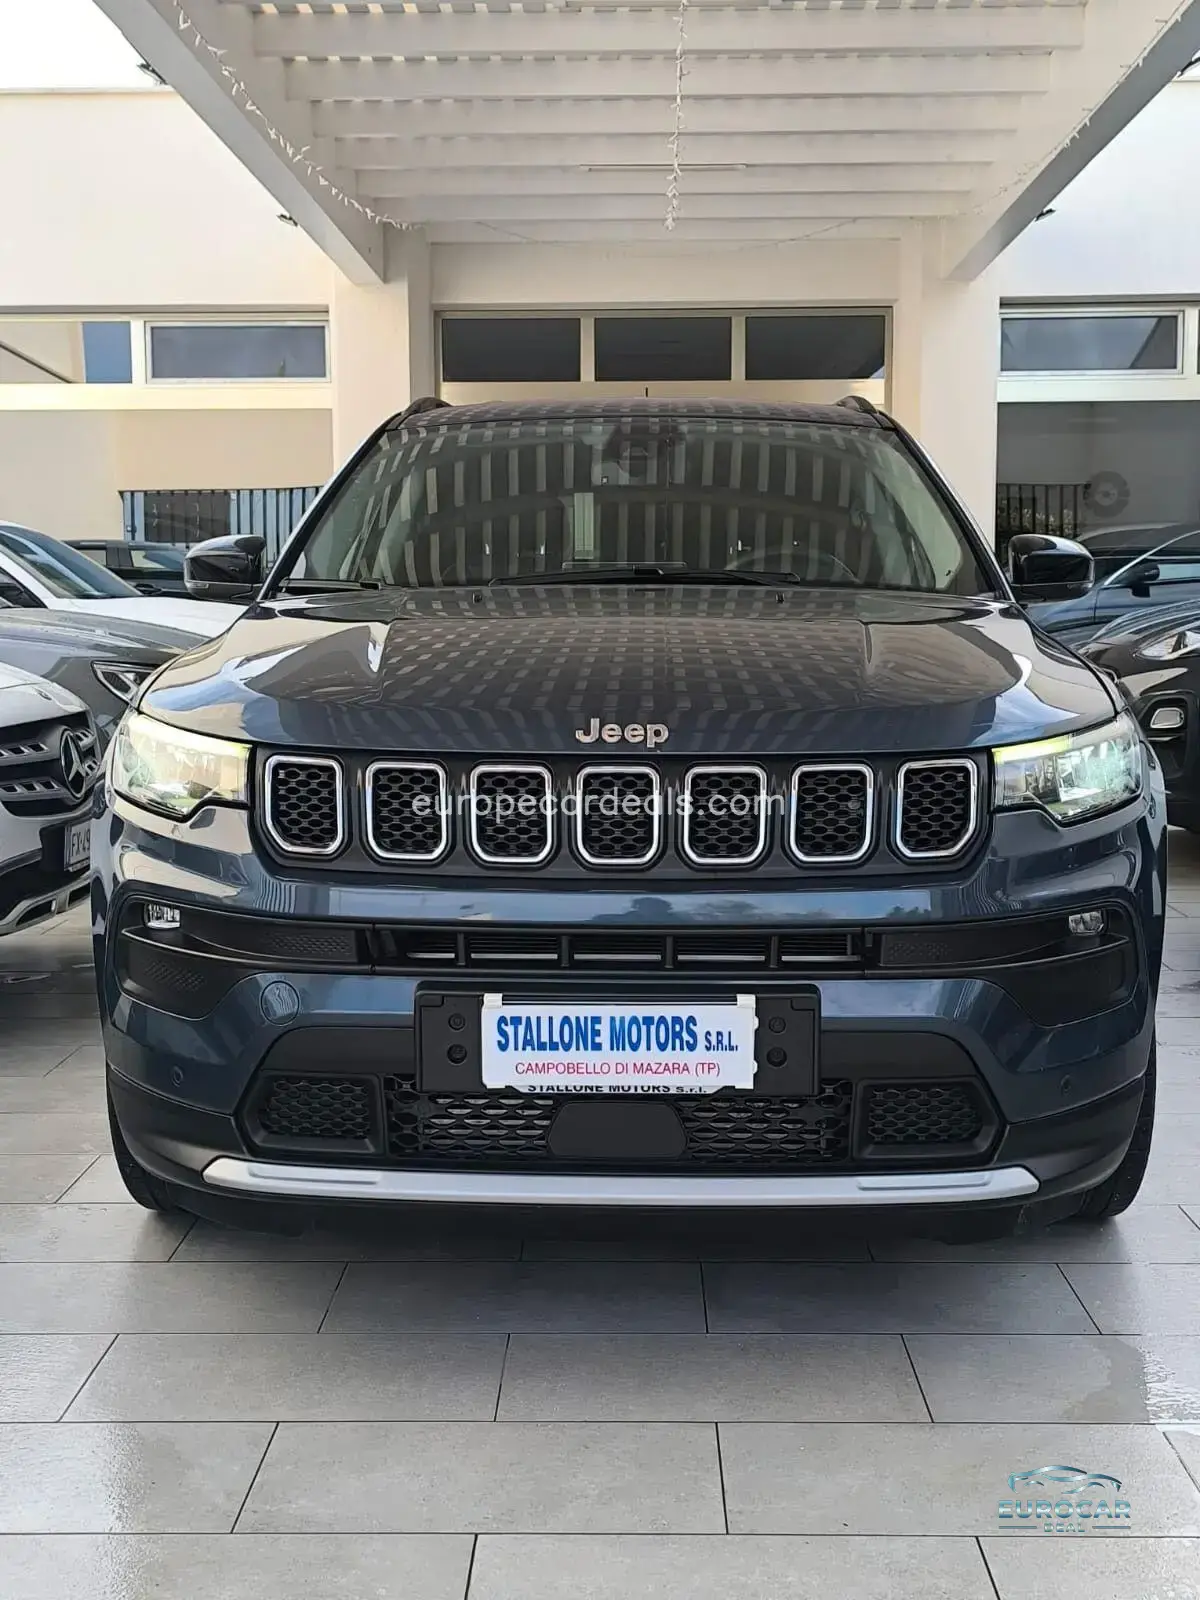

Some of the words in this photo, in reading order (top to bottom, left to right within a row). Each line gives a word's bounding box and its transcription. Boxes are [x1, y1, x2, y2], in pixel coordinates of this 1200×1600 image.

[575, 718, 670, 748] Jeep
[497, 1015, 602, 1052] STALLONE
[609, 1015, 698, 1052] MOTORS
[704, 1030, 739, 1052] S.R.L.
[515, 1062, 611, 1075] CAMPOBELLO
[615, 1062, 628, 1075] DI
[633, 1062, 690, 1075] MAZARA
[695, 1062, 720, 1076] (TP)
